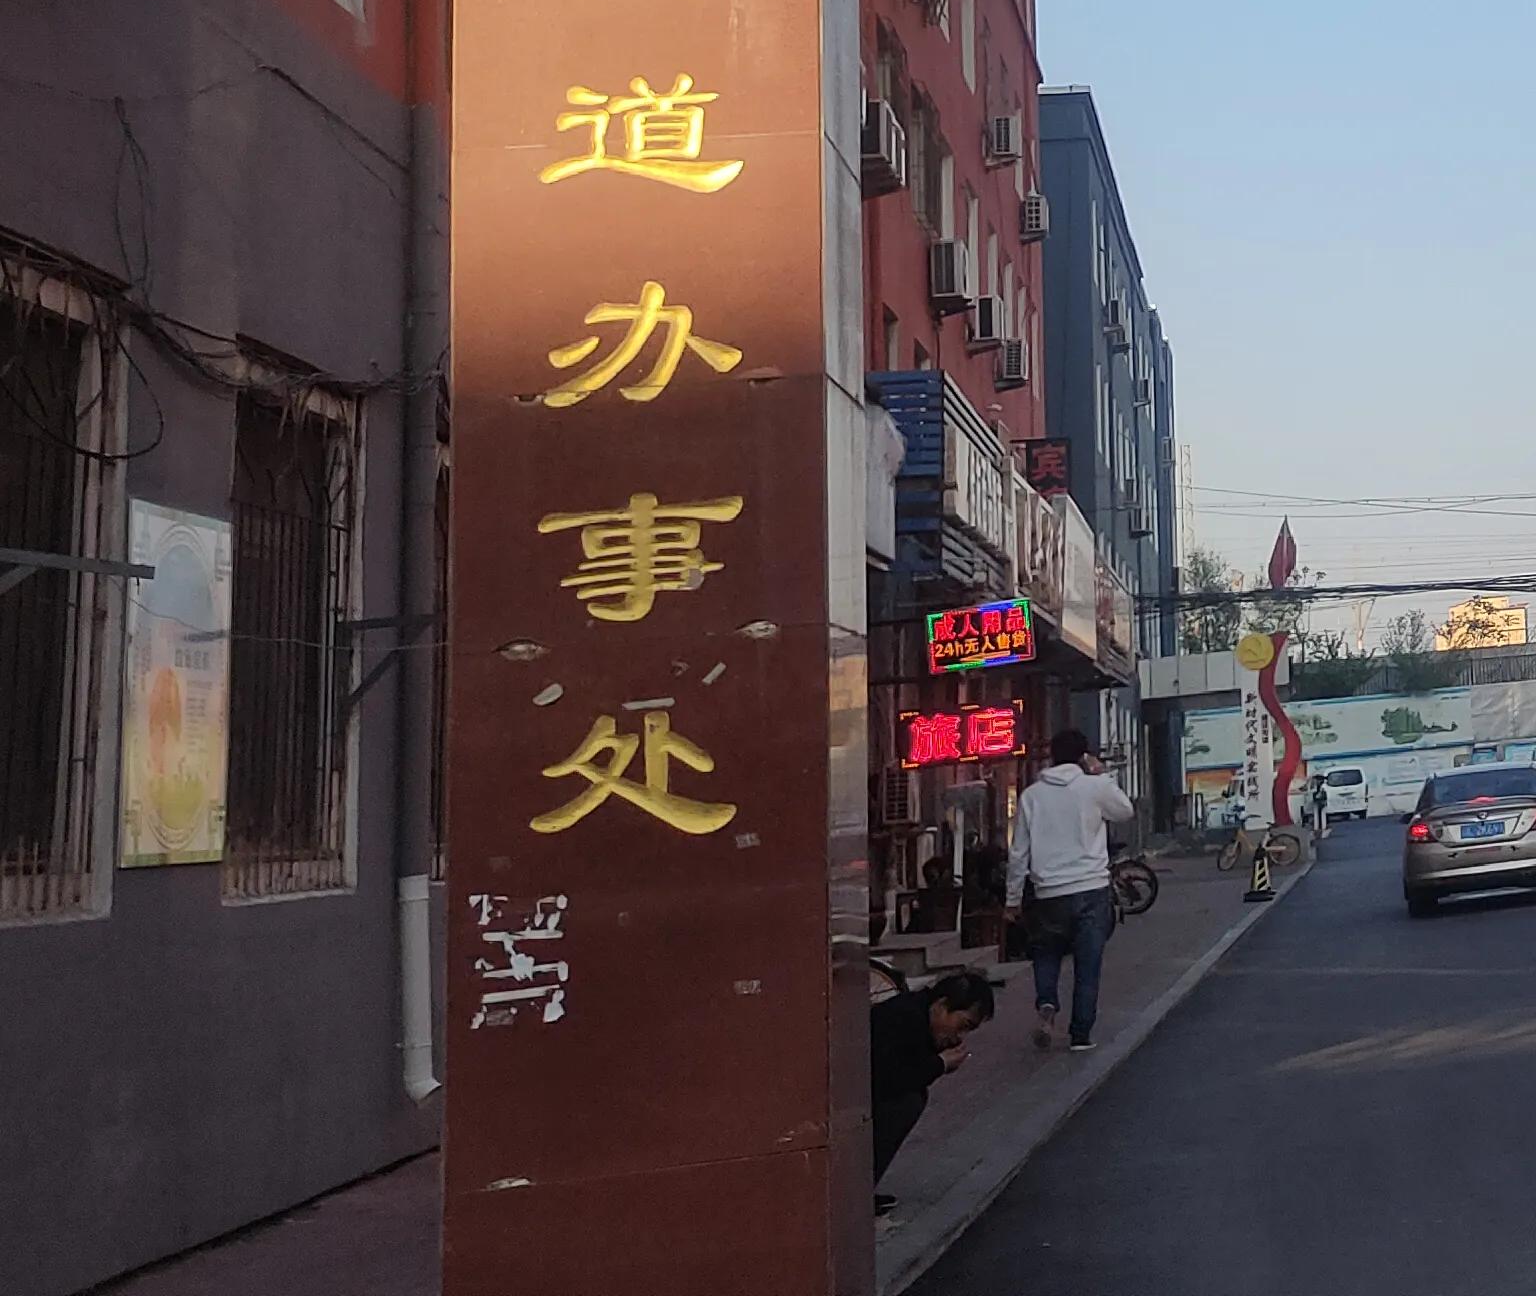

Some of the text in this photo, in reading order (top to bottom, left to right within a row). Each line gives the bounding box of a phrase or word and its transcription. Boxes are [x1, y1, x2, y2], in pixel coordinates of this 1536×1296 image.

[1032, 443, 1068, 497] 宾
[934, 606, 1026, 641] 成人用品
[934, 630, 1026, 658] 24h无人售货
[910, 707, 1015, 762] 旅店
